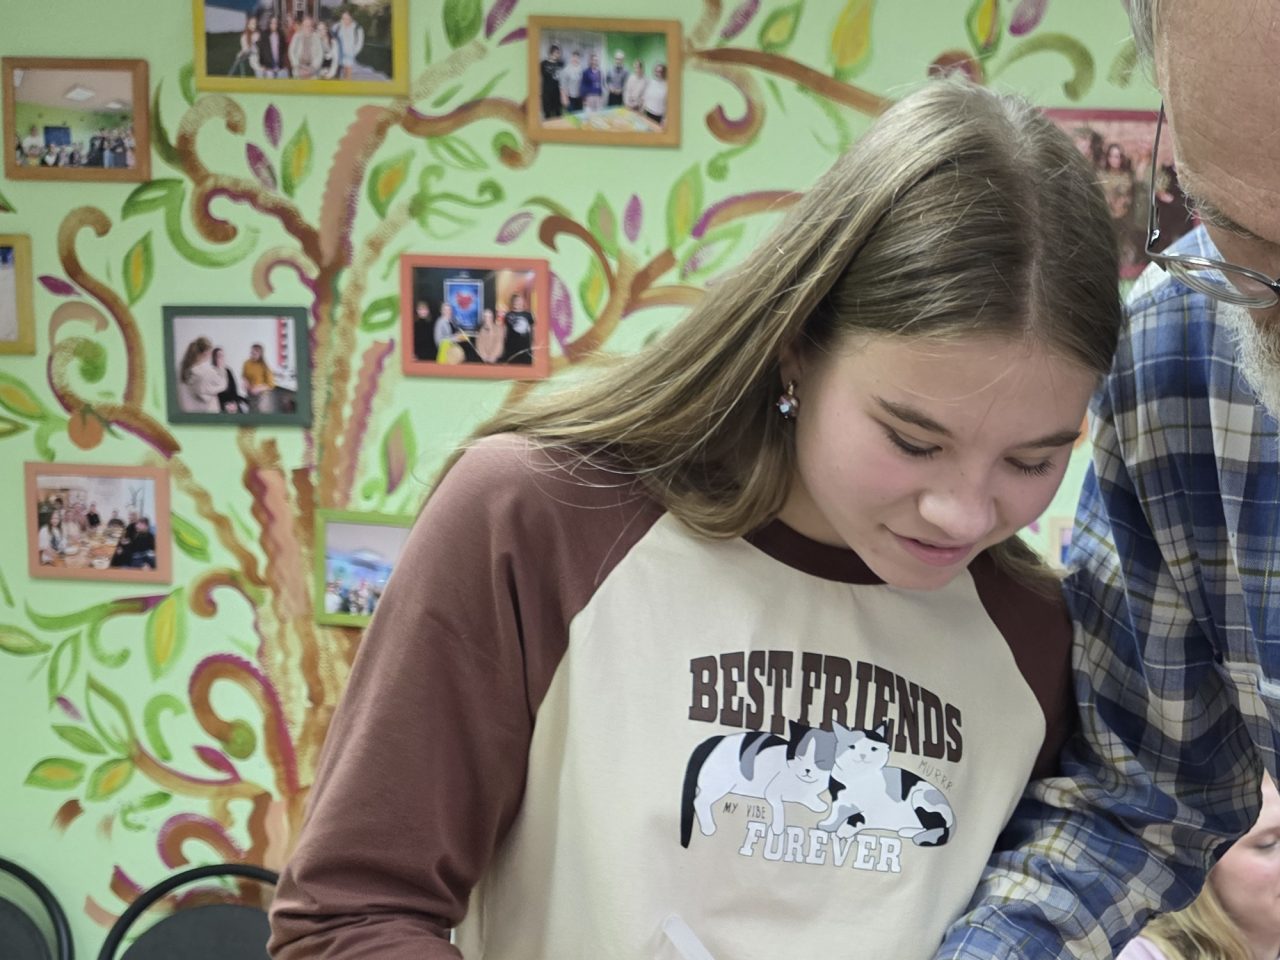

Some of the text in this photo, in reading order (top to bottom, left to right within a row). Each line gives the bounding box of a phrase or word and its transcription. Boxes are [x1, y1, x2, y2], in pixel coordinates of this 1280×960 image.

[688, 650, 963, 763] BEST FRIENDS
[723, 802, 739, 814] MY
[739, 820, 902, 873] FOREVER
